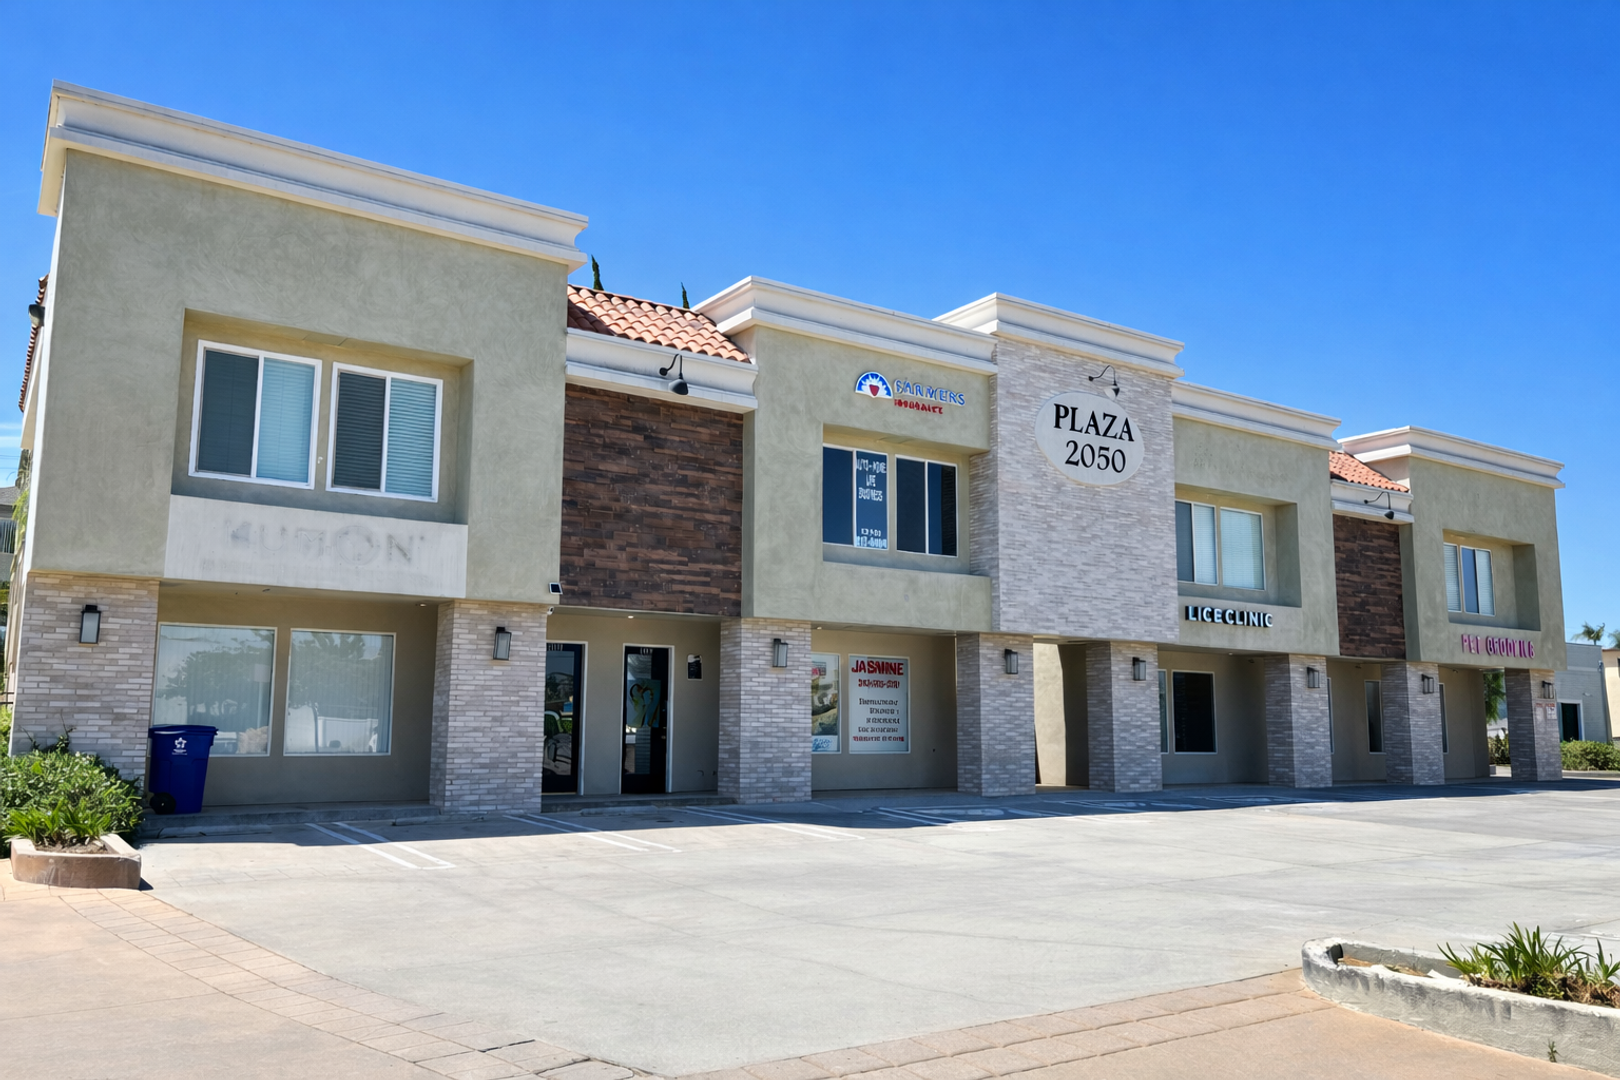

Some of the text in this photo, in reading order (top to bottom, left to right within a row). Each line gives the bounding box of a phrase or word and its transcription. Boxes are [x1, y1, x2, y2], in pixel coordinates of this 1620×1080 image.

[1053, 403, 1135, 442] PLAZA
[1064, 439, 1126, 474] 2050
[851, 659, 904, 676] JASMINE
